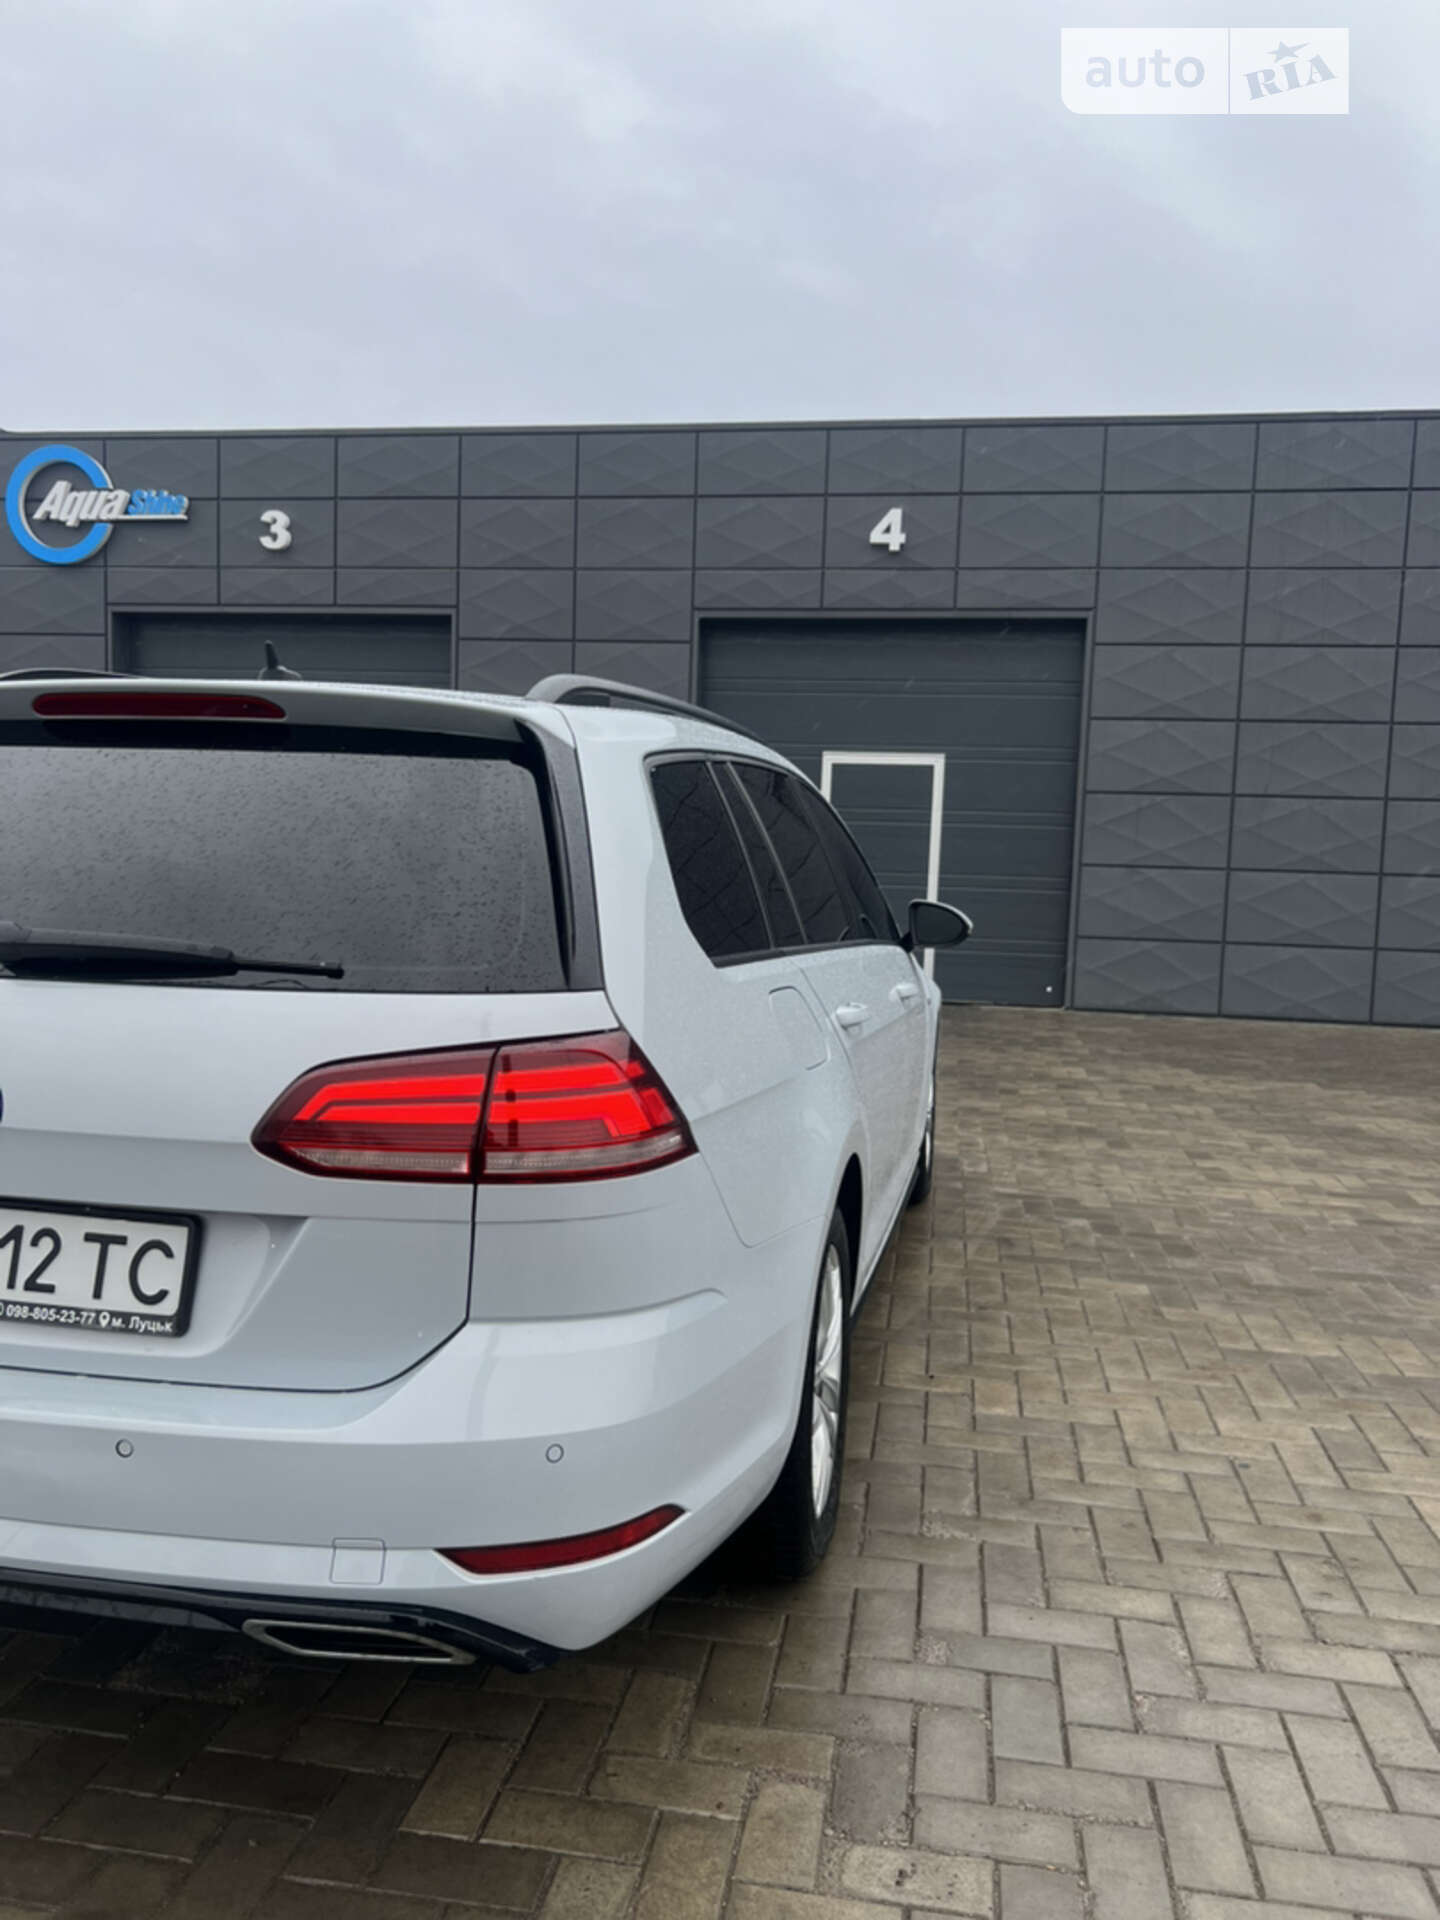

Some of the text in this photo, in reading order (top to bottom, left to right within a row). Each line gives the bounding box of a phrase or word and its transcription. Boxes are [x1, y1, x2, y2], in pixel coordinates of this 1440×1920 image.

[33, 480, 189, 527] Aqua Shine
[259, 509, 292, 550] 3
[869, 507, 906, 551] 4
[84, 1232, 174, 1306] TC
[129, 1316, 173, 1333] Луцьк
